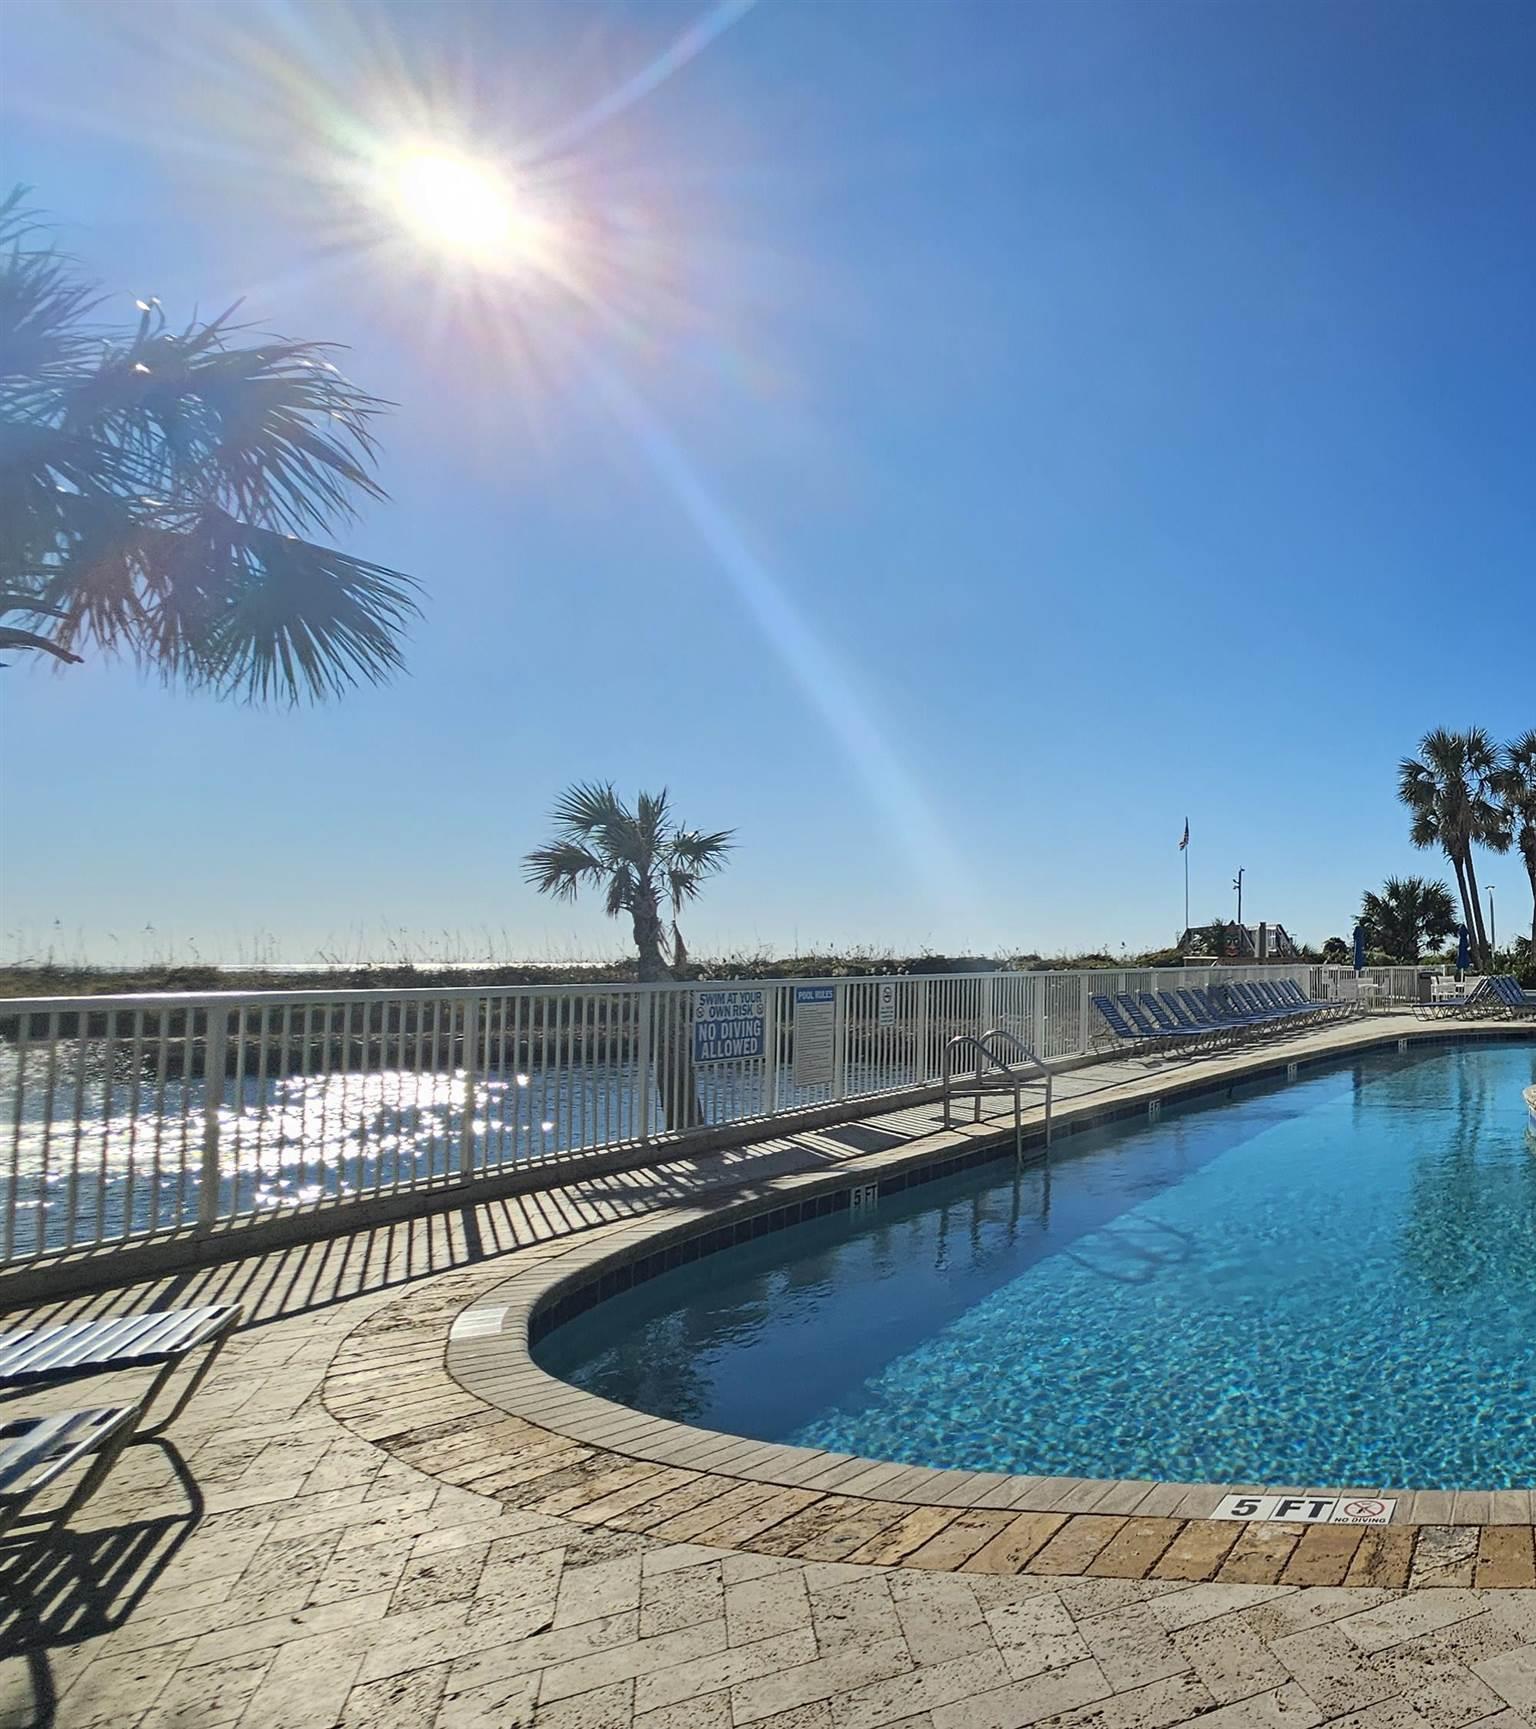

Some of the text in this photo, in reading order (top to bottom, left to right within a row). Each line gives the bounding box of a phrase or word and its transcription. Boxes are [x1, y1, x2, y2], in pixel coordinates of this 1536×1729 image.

[699, 991, 762, 1006] SWIM AT YOUR
[798, 990, 814, 1000] POOL
[709, 1004, 753, 1018] OWN RISK
[698, 1020, 761, 1041] NO DIVING
[701, 1037, 758, 1059] ALLOWED
[853, 1184, 877, 1206] 5 FT
[1231, 1499, 1334, 1518] 5 FT
